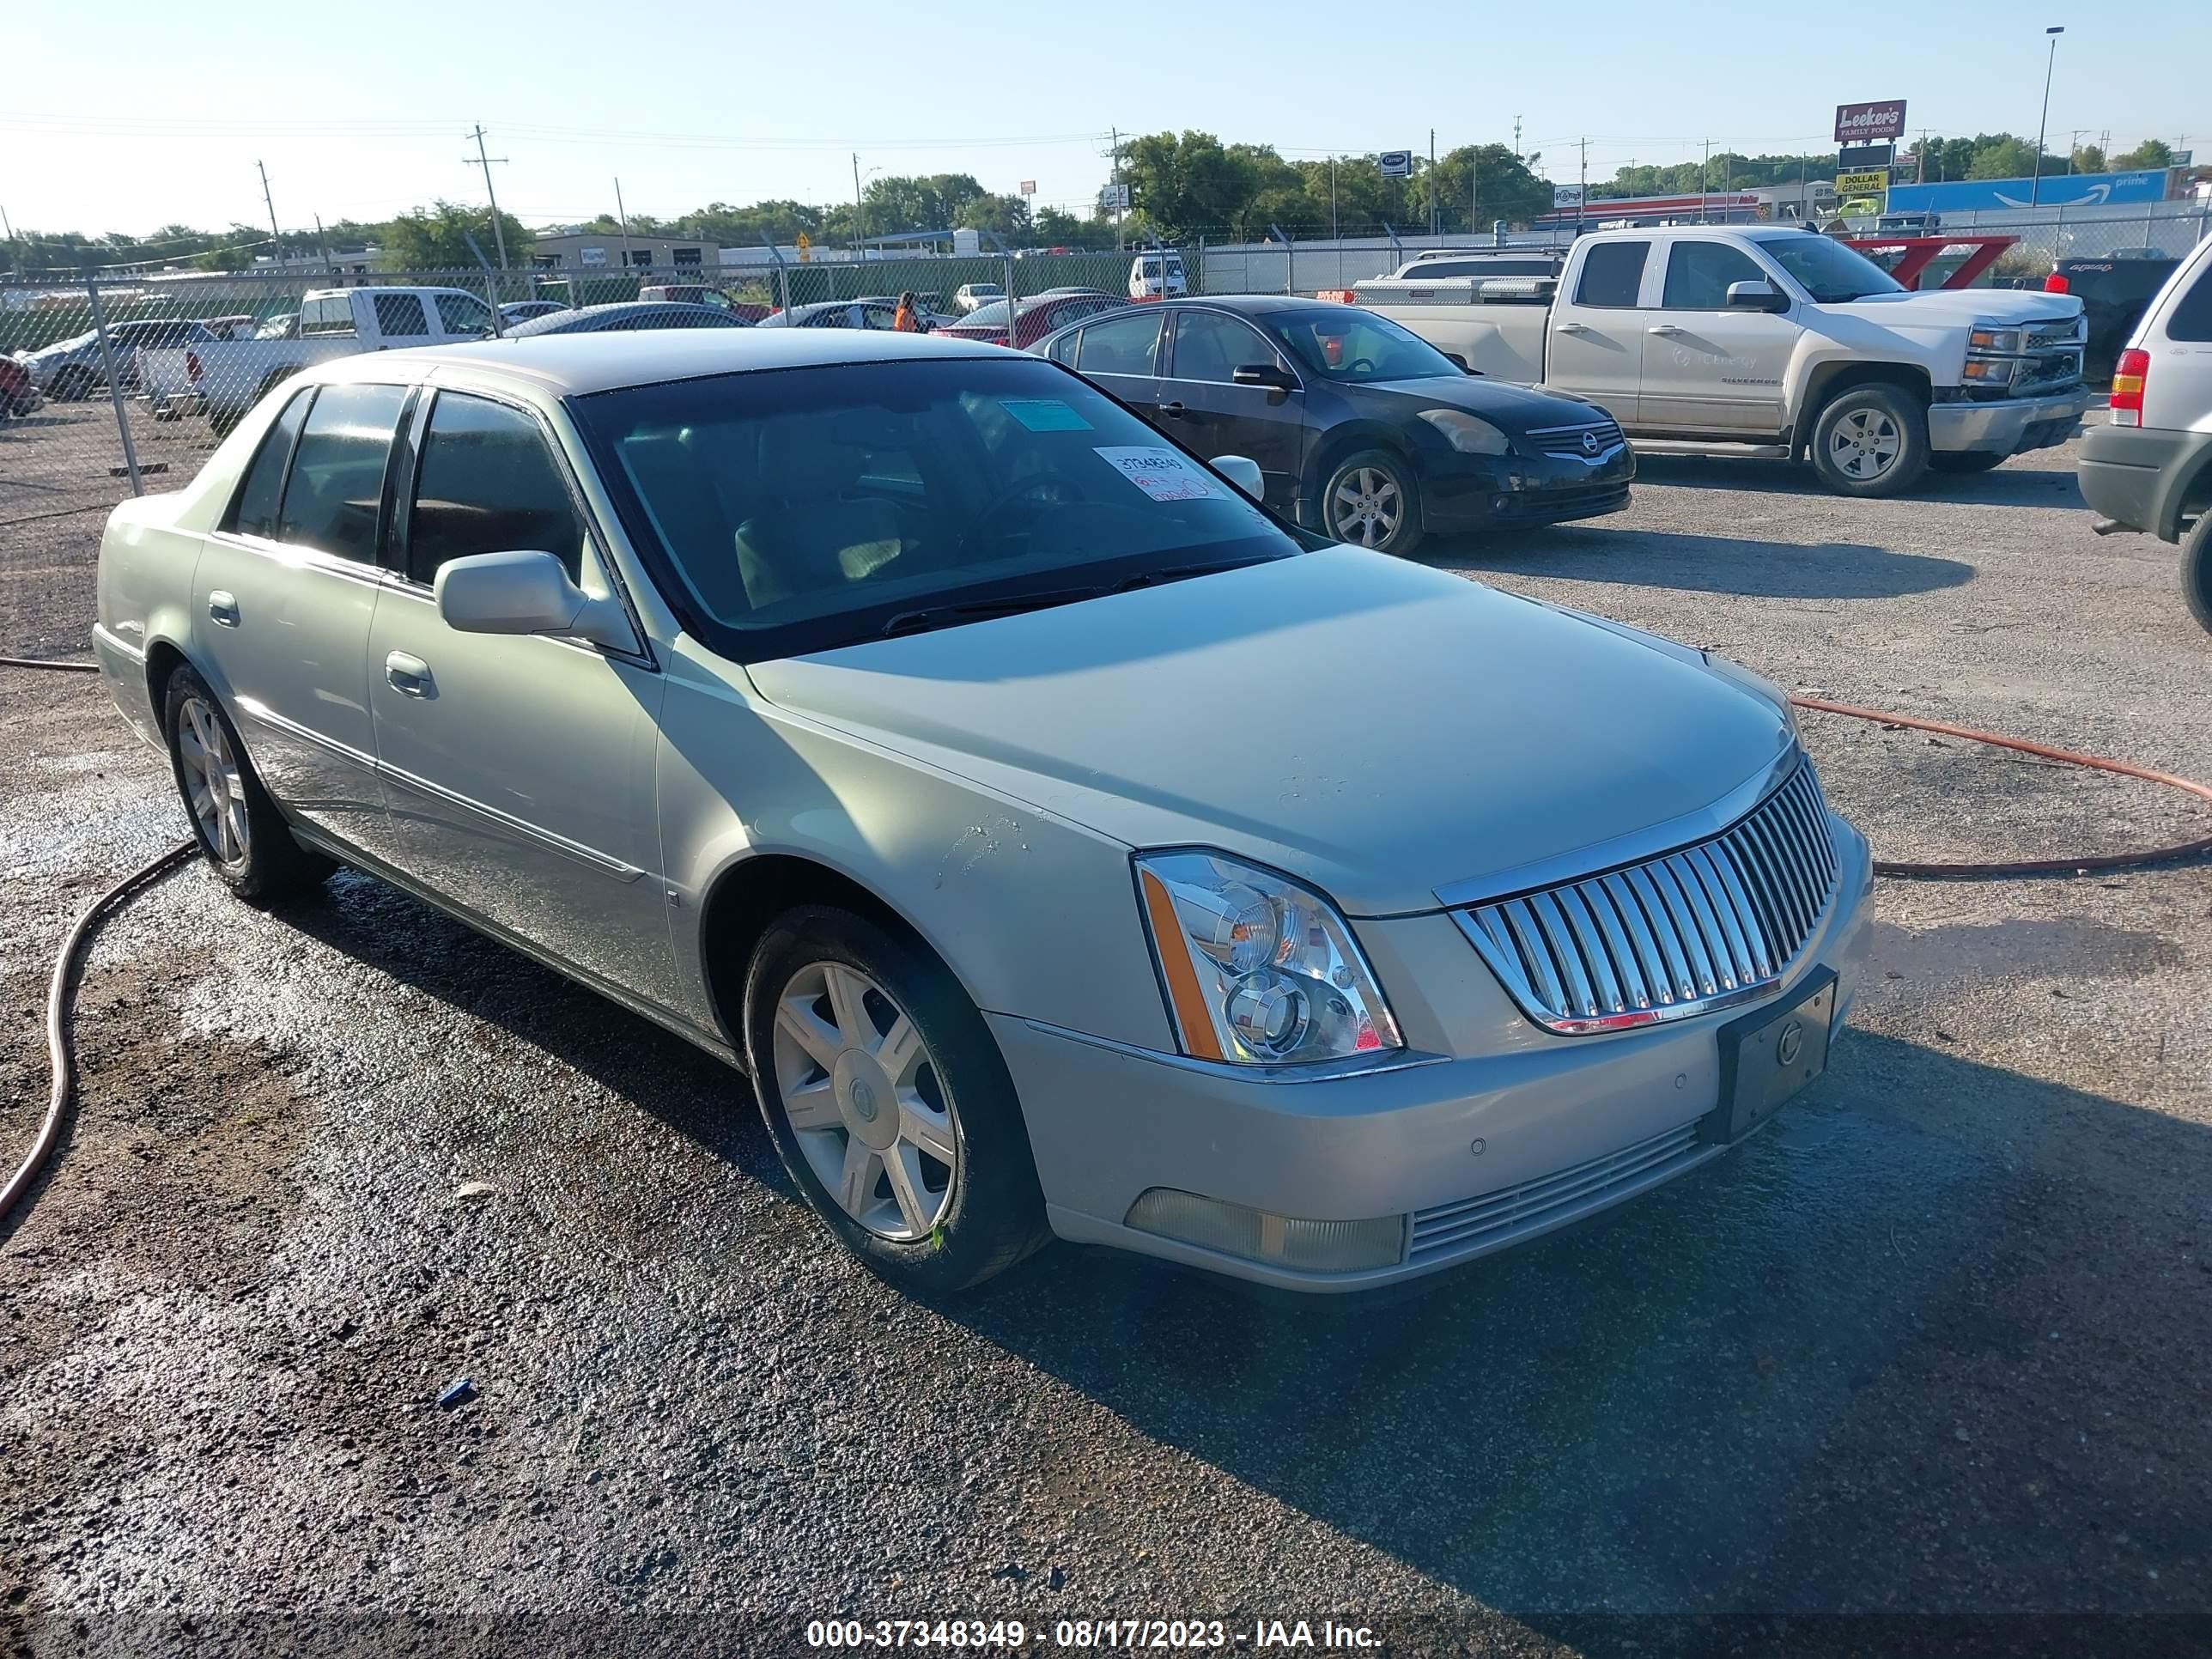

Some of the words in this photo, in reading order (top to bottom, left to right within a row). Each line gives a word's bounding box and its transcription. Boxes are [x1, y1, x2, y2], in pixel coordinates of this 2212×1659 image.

[1839, 106, 1899, 128] Leeker's
[1841, 128, 1869, 137] FAMILY
[1845, 174, 1880, 184] DOLLAR
[2116, 176, 2148, 189] prime
[1842, 183, 1881, 192] GENERAL
[1721, 376, 1778, 386] SILVERADO
[1117, 457, 1183, 470] 37348349
